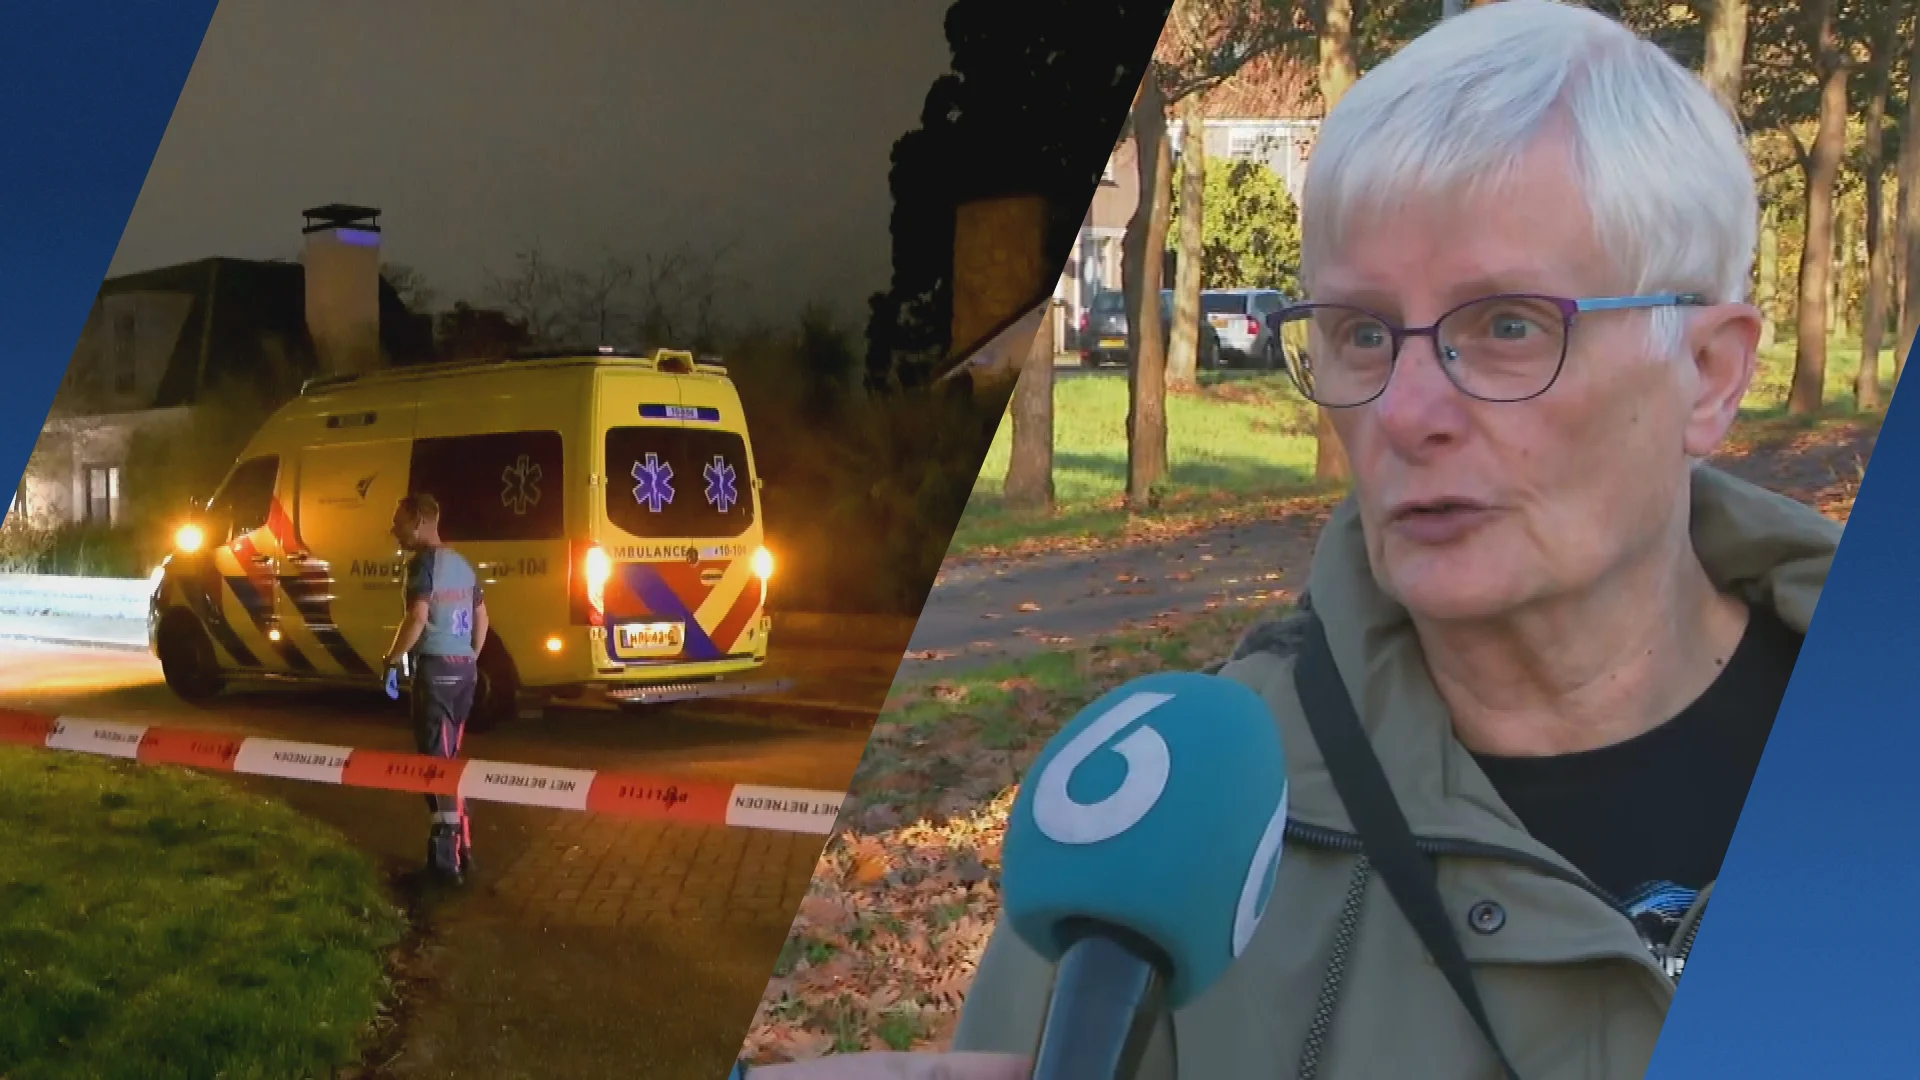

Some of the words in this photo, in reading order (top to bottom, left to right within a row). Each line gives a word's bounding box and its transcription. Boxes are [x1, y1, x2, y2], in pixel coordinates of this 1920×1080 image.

[273, 751, 327, 767] BETREDEN
[327, 755, 351, 769] NIET
[1033, 692, 1176, 845] 6
[484, 773, 547, 789] BETREDEN
[551, 779, 576, 793] NIET
[735, 796, 809, 814] BETREDEN
